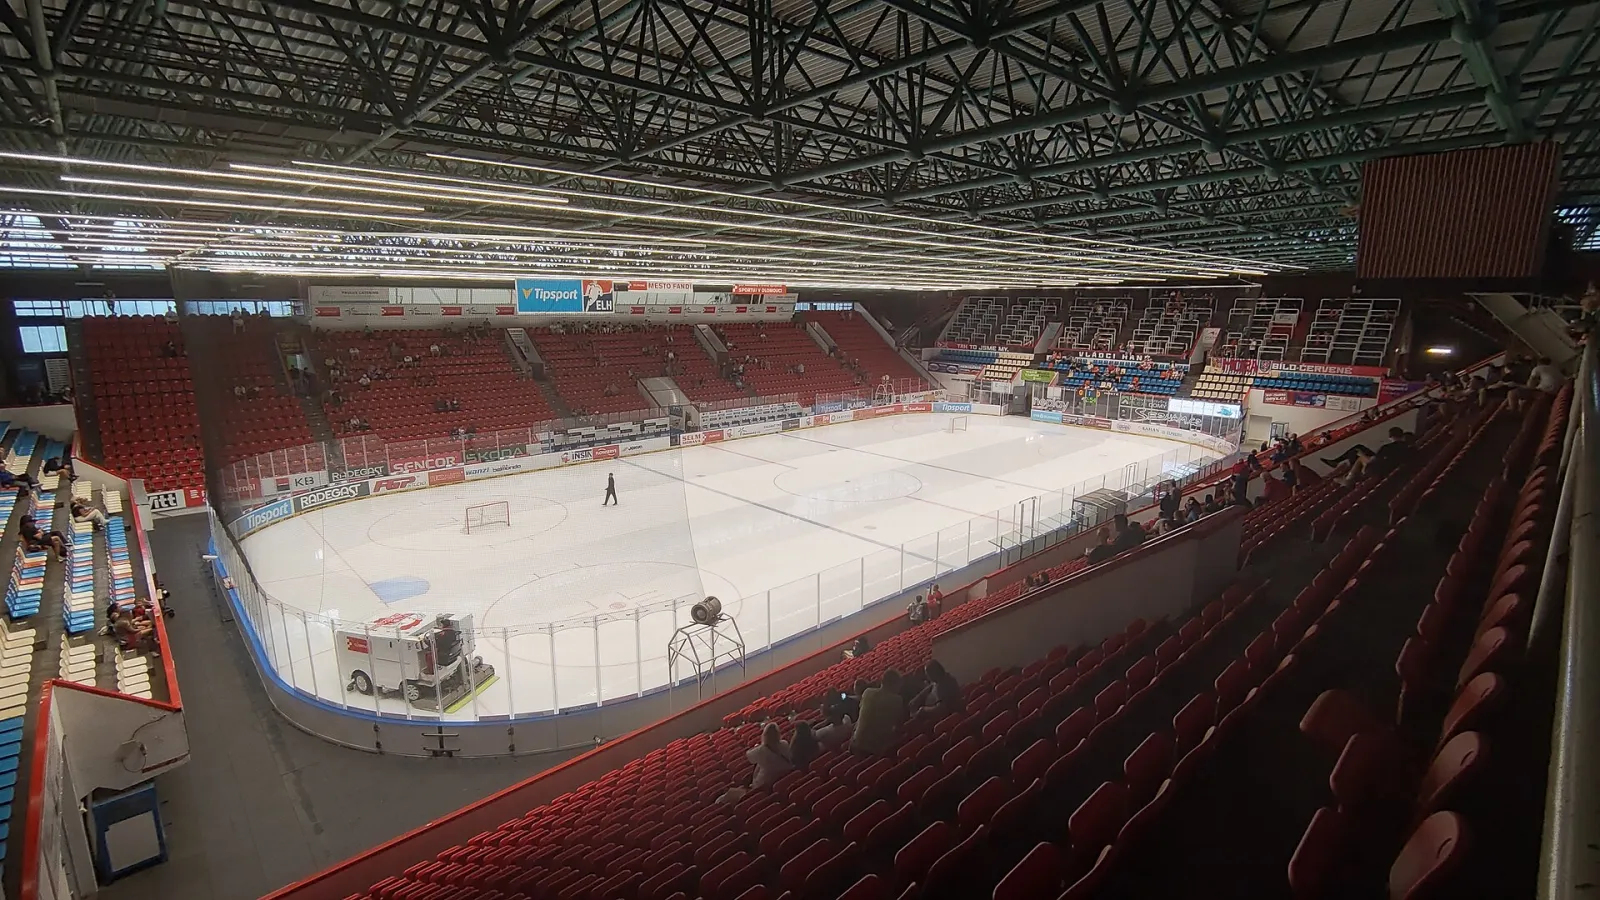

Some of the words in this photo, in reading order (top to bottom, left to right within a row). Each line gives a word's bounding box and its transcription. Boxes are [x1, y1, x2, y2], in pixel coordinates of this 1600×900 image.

[534, 287, 578, 302] Tipsport
[596, 300, 613, 311] ELH
[941, 403, 970, 412] Tipsport
[332, 465, 385, 482] RADEGAST
[393, 456, 456, 475] SENCOR
[294, 476, 315, 488] KB
[300, 483, 362, 510] RADEGAST
[246, 502, 289, 529] Tipsport
